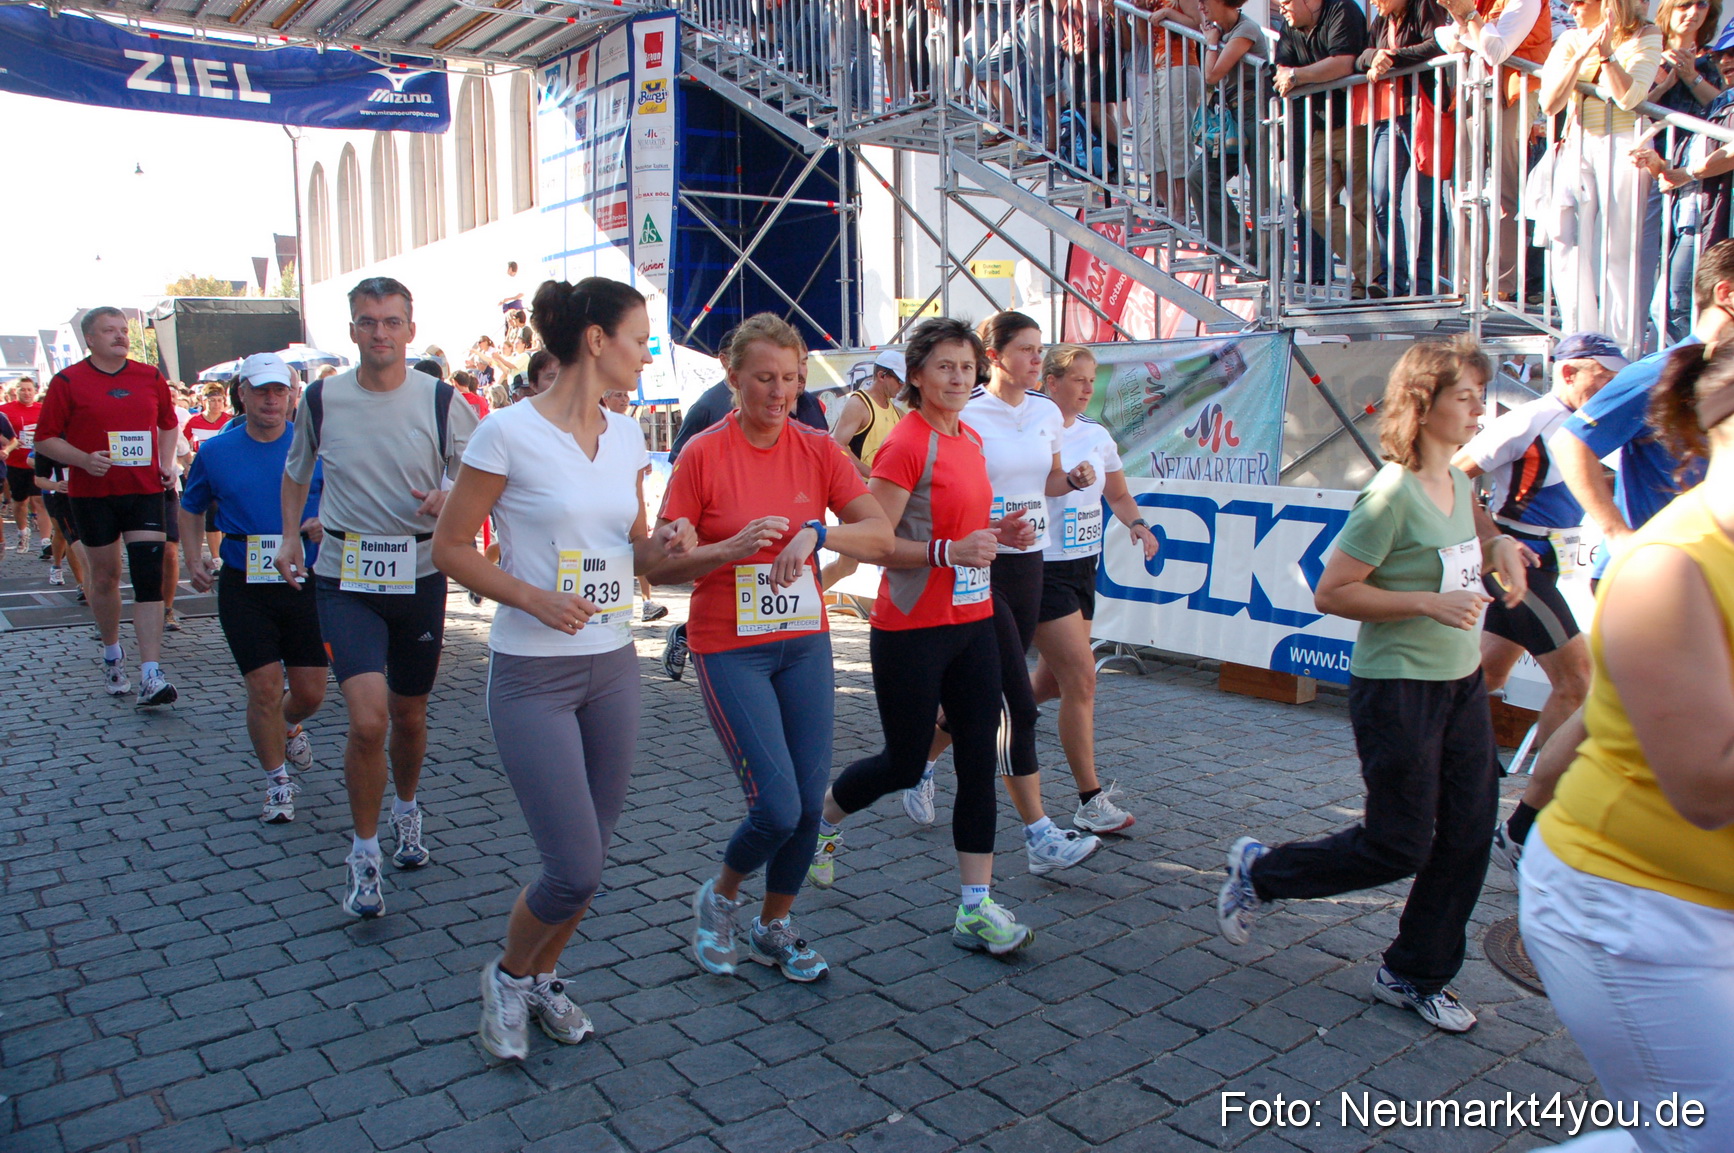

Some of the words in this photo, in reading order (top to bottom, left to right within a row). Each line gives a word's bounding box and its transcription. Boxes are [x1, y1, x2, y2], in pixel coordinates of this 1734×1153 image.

[124, 49, 271, 104] ZIEL
[360, 109, 440, 119] www.mizunoeurope.com
[122, 446, 144, 457] 840
[1006, 500, 1042, 512] Christine
[1067, 525, 1074, 534] D
[361, 540, 409, 553] Reinhard
[250, 553, 258, 561] D
[347, 554, 355, 564] C
[362, 559, 397, 578] 701
[583, 558, 606, 572] Ulla
[563, 579, 573, 592] D
[583, 581, 620, 604] 839
[741, 592, 751, 603] D
[760, 595, 800, 615] 807
